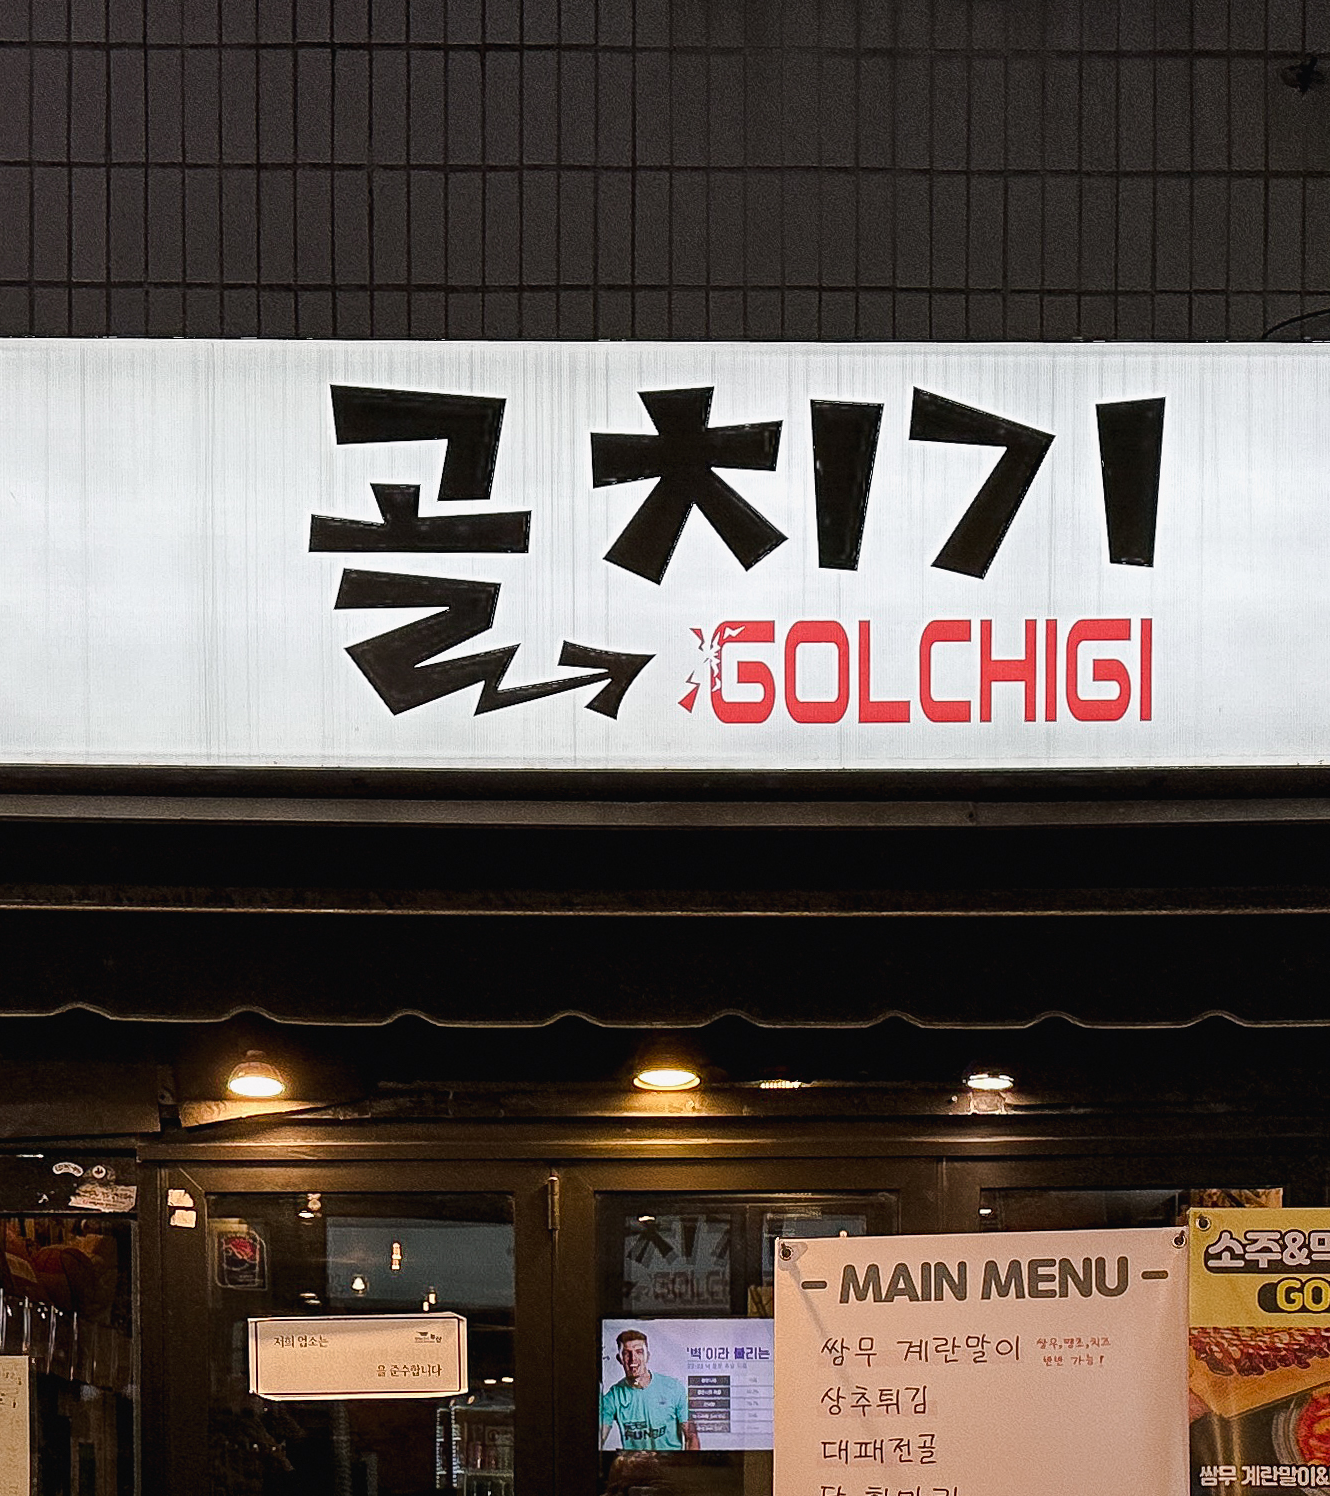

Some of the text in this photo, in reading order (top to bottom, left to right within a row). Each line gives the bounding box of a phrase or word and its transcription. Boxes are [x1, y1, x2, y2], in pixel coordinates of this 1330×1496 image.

[309, 384, 1166, 719] 골치기
[679, 618, 1153, 724] GOLCHIGI
[839, 1255, 1130, 1304] MAIN MENU
[274, 1335, 329, 1348] 저희 업소는
[820, 1333, 1021, 1367] 쌈무 계란말이
[376, 1364, 442, 1377] 을 준수합니다
[820, 1385, 928, 1416] 상추튀김
[820, 1433, 938, 1465] 대패전골
[1199, 1464, 1237, 1487] 쌈무
